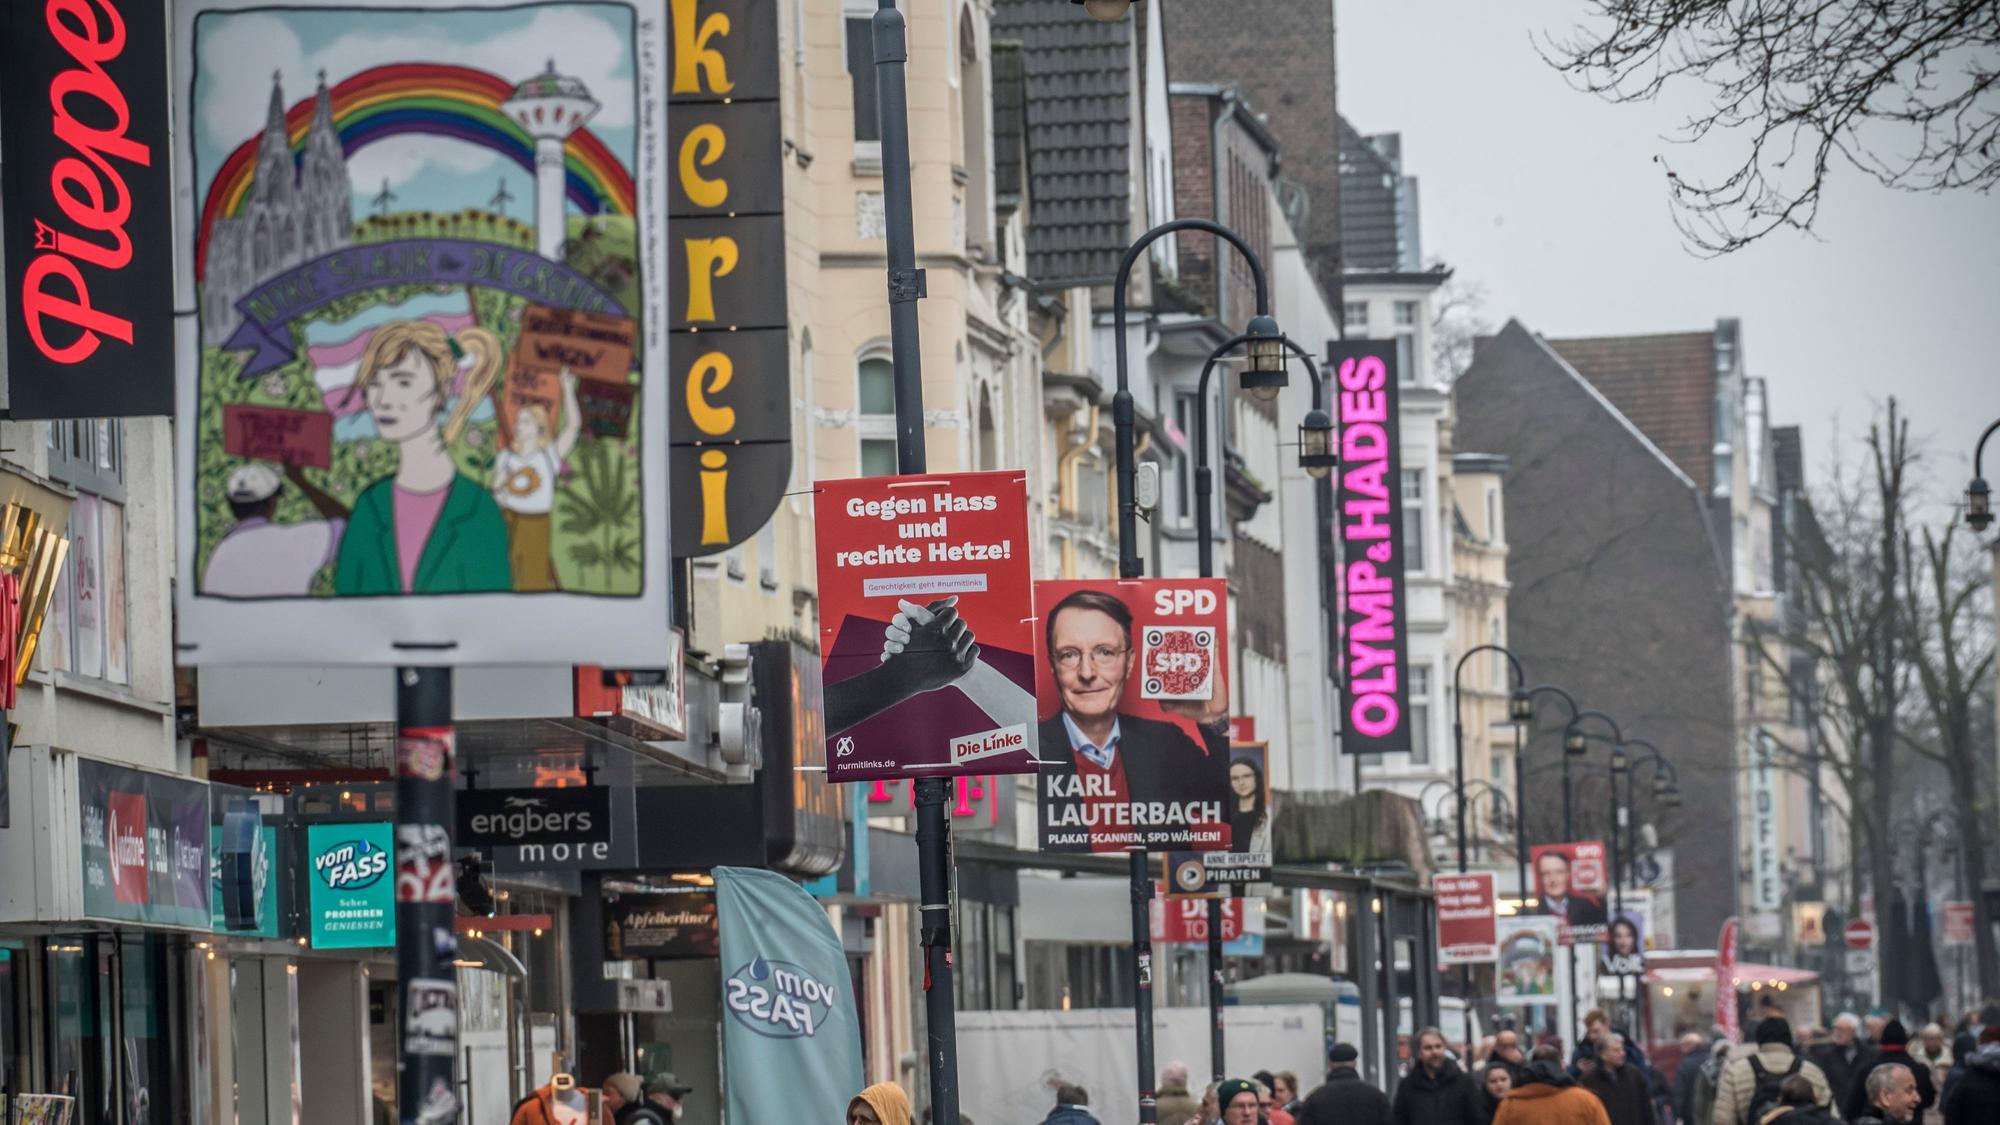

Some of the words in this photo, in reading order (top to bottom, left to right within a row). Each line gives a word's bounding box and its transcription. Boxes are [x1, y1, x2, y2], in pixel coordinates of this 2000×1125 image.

[847, 496, 926, 521] Gegen
[933, 493, 998, 513] Hass
[898, 517, 947, 539] und
[837, 545, 922, 568] rechte
[928, 540, 1011, 562] Hetze!
[868, 582, 917, 593] Gerechtigkeit
[918, 581, 935, 591] geht
[937, 579, 983, 589] #nurmitlinks
[1154, 588, 1217, 616] SPD
[1155, 652, 1202, 673] SPD
[957, 741, 980, 757] Die
[983, 732, 1022, 752] Linke
[837, 759, 896, 771] nurmitlinks.de
[1047, 774, 1116, 798] KARL
[471, 807, 592, 838] engbers
[1048, 801, 1221, 827] LAUTERBACH
[1048, 833, 1089, 845] PLAKAT
[1091, 832, 1147, 844] SCANNEN,
[1148, 832, 1169, 842] SPD
[1171, 829, 1221, 842] WÄHLEN!
[316, 846, 354, 870] vom
[519, 842, 609, 862] more
[330, 851, 387, 888] FASS
[1206, 869, 1261, 881] PIRATEN
[325, 909, 384, 919] PROBIEREN
[623, 910, 712, 929] Apfelberliner
[324, 920, 384, 931] GENIESSEN
[1603, 954, 1643, 974] Volt
